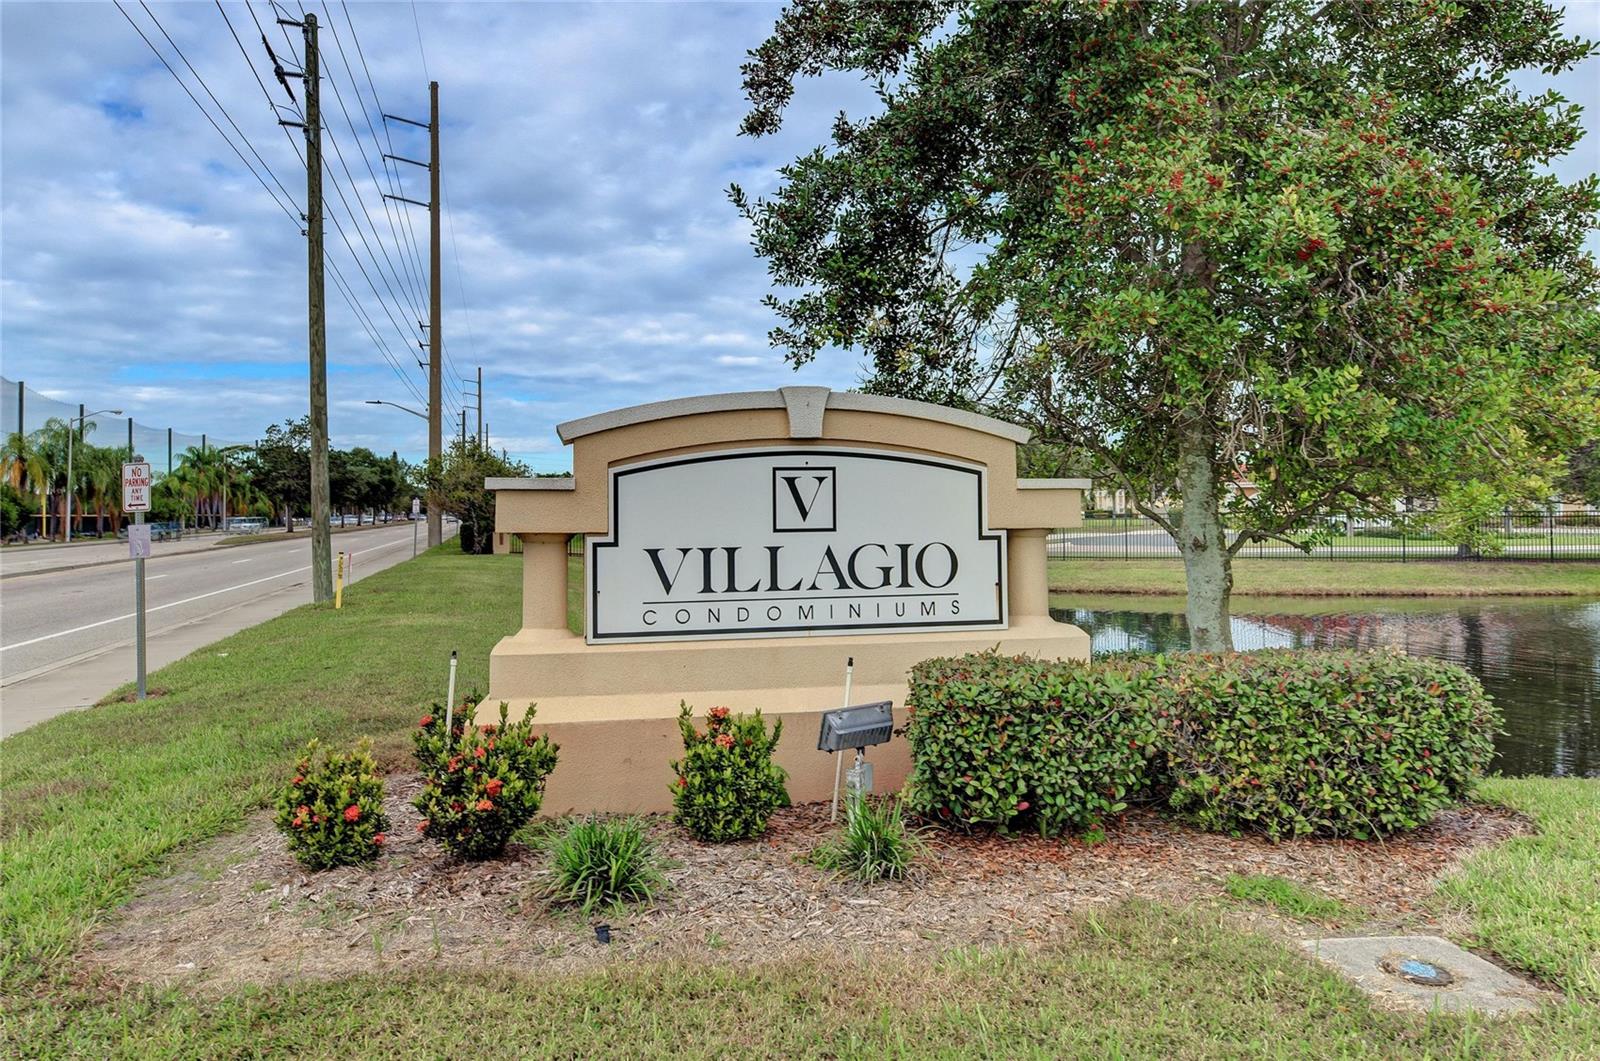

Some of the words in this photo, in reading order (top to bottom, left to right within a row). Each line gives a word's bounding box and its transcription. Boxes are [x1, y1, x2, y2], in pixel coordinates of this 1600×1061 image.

[125, 478, 149, 487] PARKING
[132, 467, 142, 477] NO
[780, 476, 829, 523] V
[642, 541, 959, 596] VILLAGIO
[642, 599, 960, 626] CONDOMINIUMS
